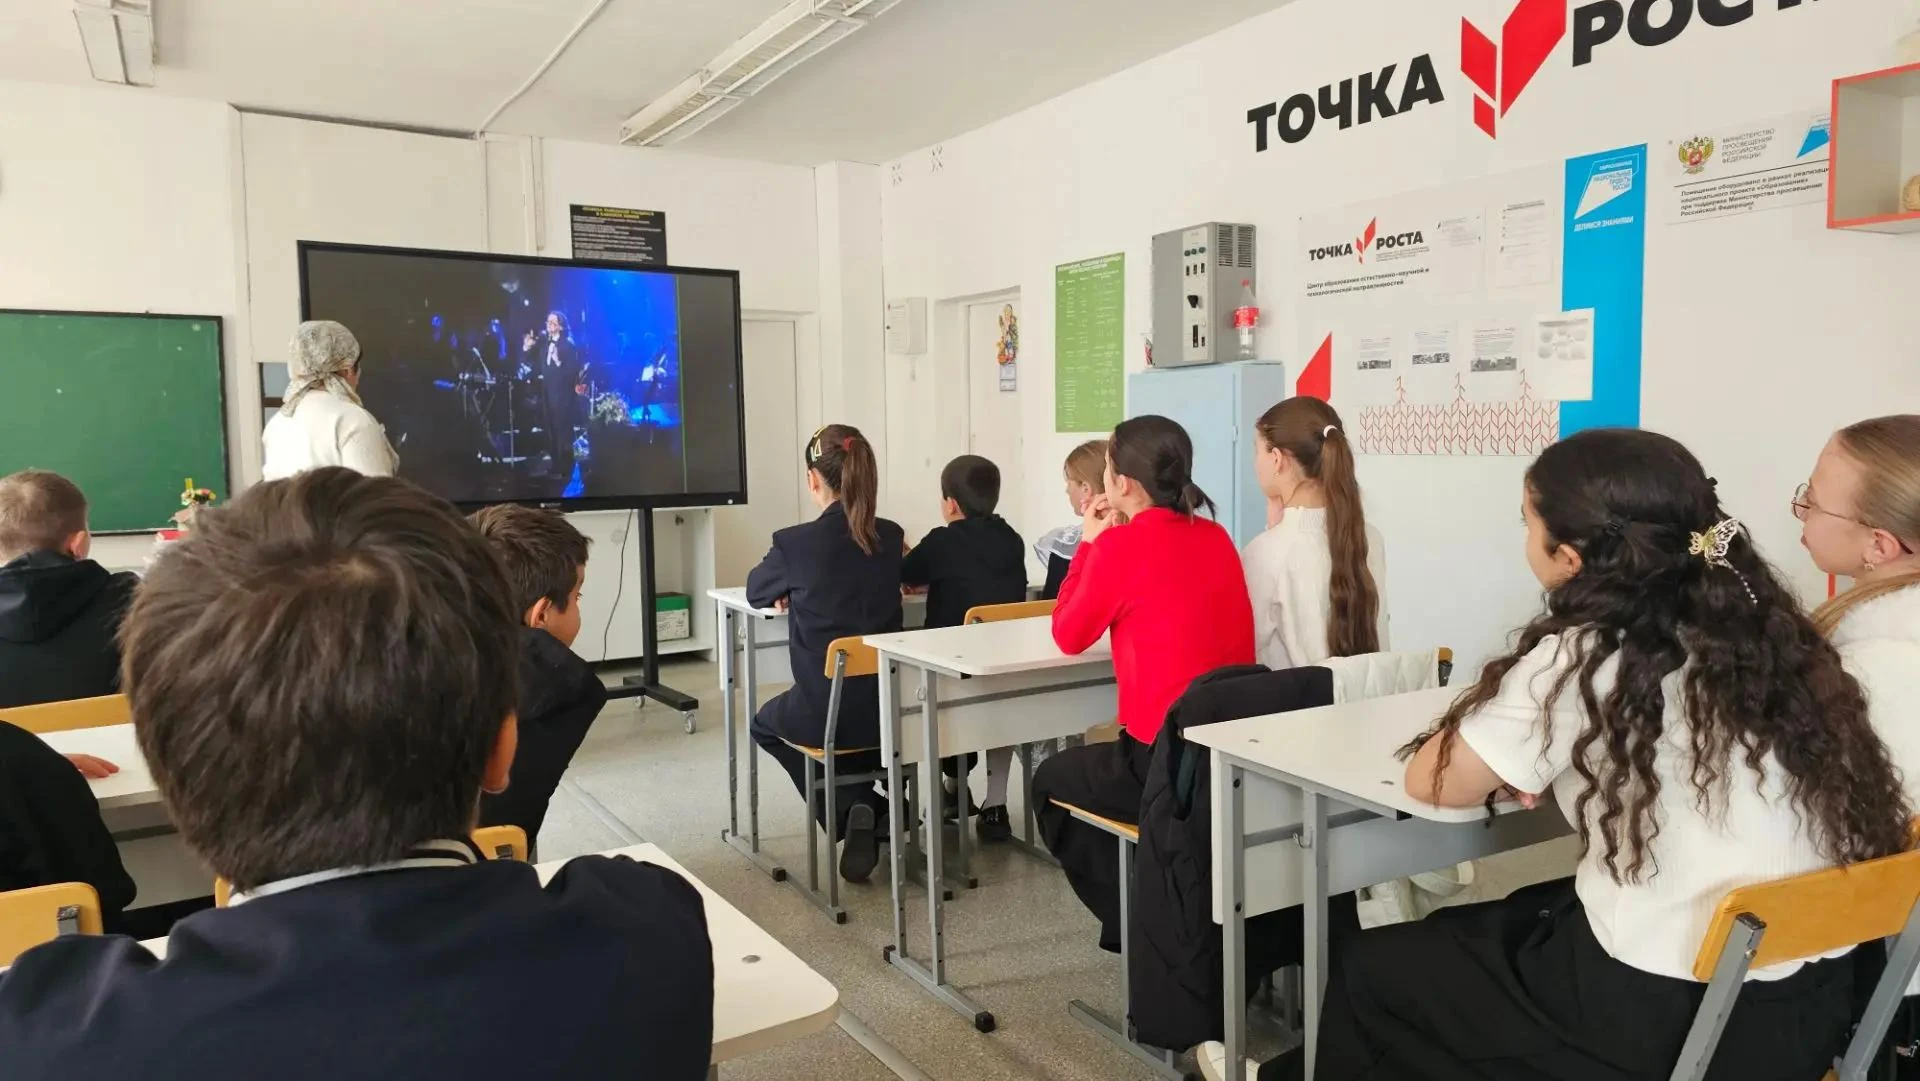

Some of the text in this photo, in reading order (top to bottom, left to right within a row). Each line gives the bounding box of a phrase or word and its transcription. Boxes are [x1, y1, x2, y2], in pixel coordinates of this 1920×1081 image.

[1247, 53, 1444, 152] ТОЧКА
[1309, 243, 1353, 261] ТОЧКА
[1376, 231, 1424, 250] РОСТА
